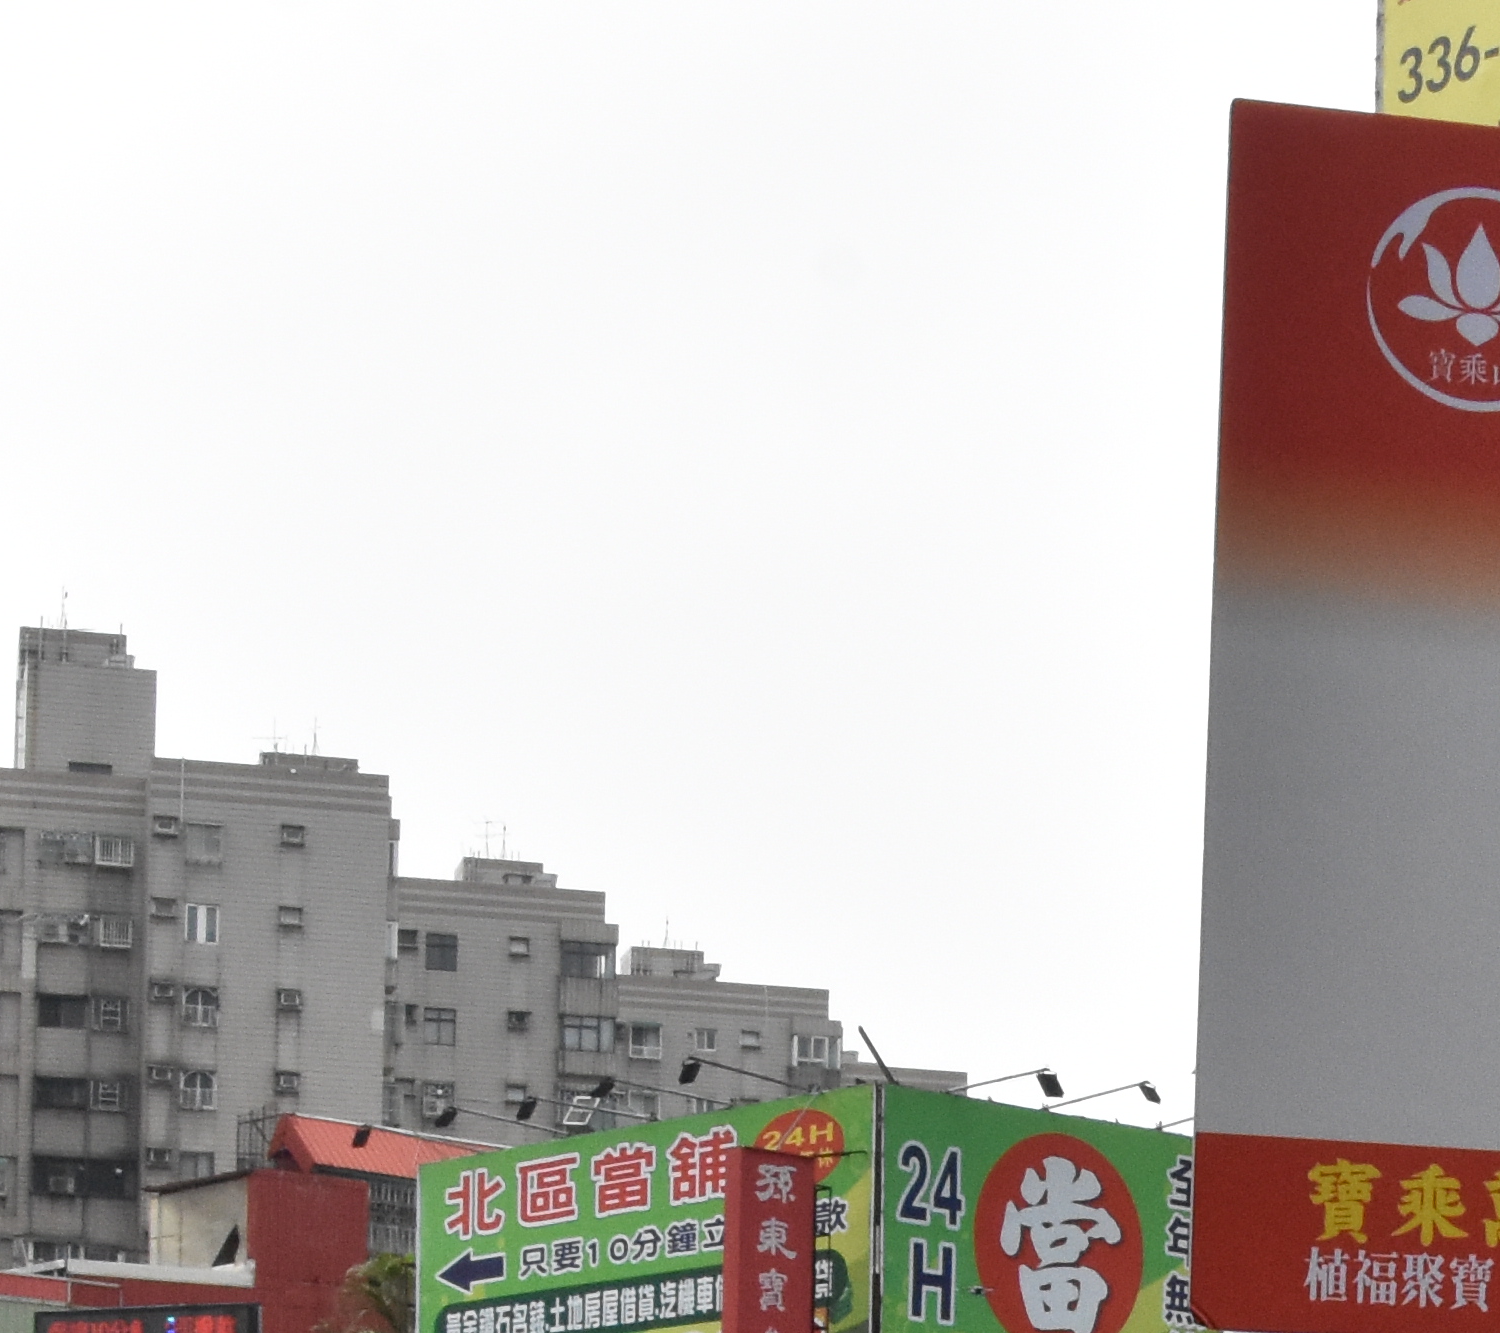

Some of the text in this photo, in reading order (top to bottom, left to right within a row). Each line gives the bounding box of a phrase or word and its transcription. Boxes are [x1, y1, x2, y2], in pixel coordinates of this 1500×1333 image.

[897, 1140, 965, 1231] 24
[909, 1238, 956, 1326] H
[1303, 1246, 1494, 1314] 植福聚寶
